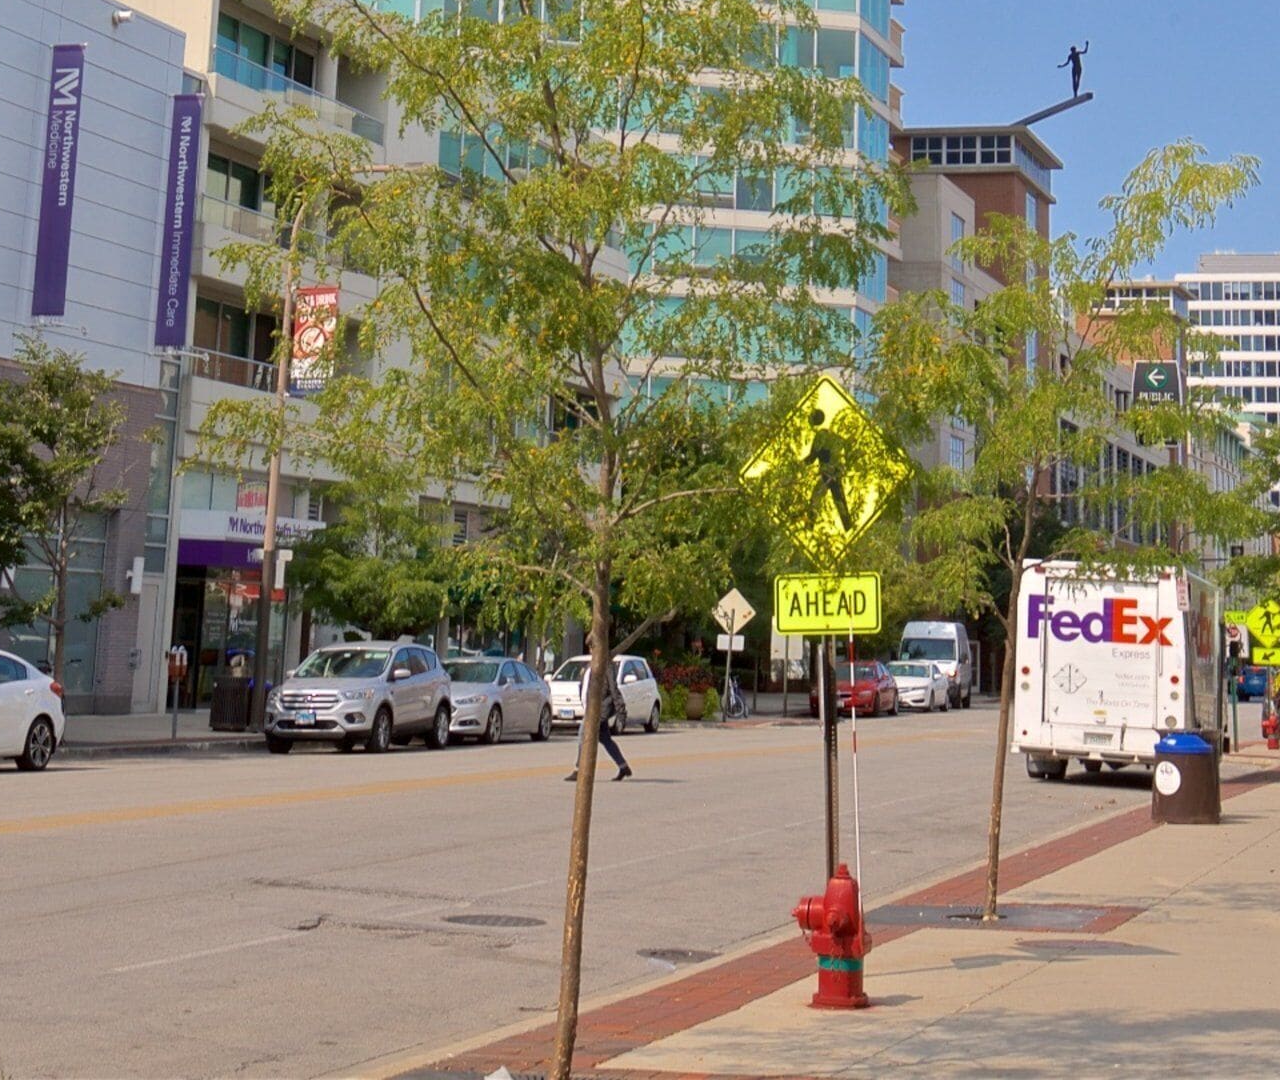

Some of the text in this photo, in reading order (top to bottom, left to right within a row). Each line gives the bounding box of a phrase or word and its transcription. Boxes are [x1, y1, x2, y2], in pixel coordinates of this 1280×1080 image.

[47, 110, 64, 169] Medicine
[57, 110, 77, 207] Northwestern
[173, 135, 192, 229] Northwestern
[168, 231, 185, 296] Immediate
[166, 298, 179, 328] Care
[1138, 391, 1175, 402] PUBLIC
[788, 590, 867, 618] AHEAD
[1027, 594, 1173, 647] FedEx
[1111, 647, 1151, 661] Express
